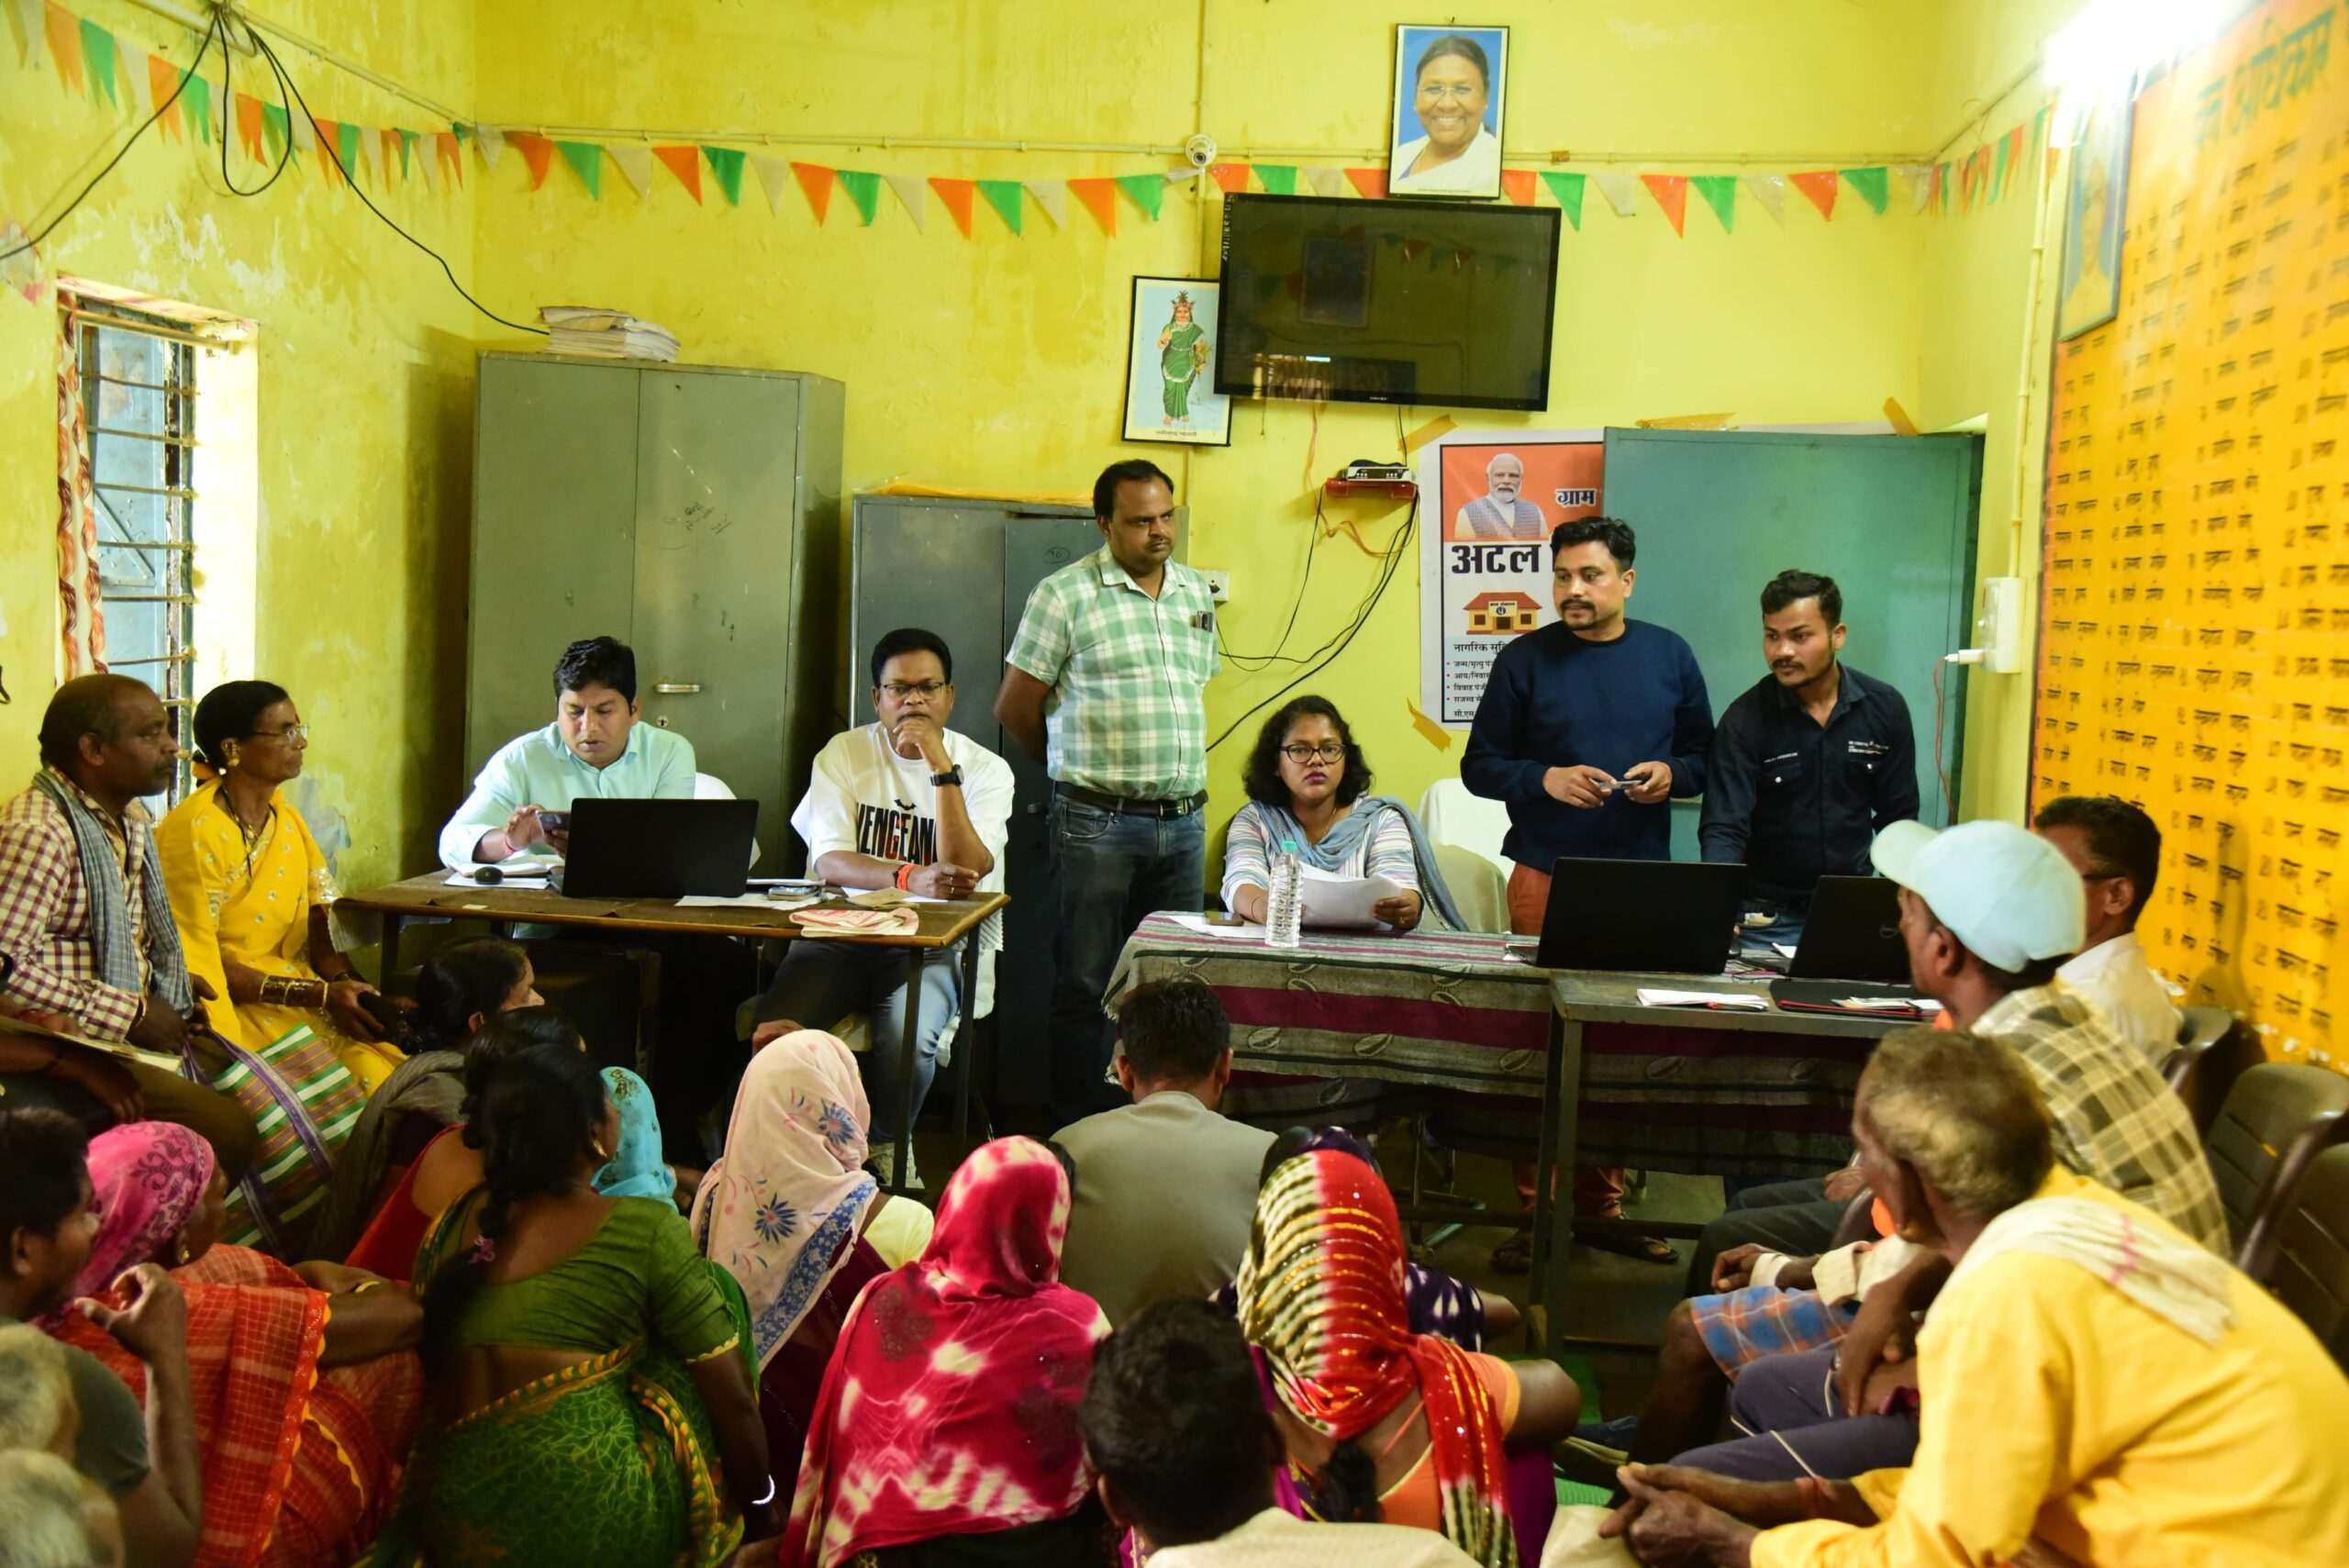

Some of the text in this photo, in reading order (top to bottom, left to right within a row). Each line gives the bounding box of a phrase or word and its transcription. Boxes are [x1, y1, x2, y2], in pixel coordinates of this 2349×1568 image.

[1555, 488, 1597, 506] ग्राम
[1452, 544, 1542, 573] अटल
[1453, 641, 1488, 652] नागरिक
[857, 801, 938, 866] VENGEAN
